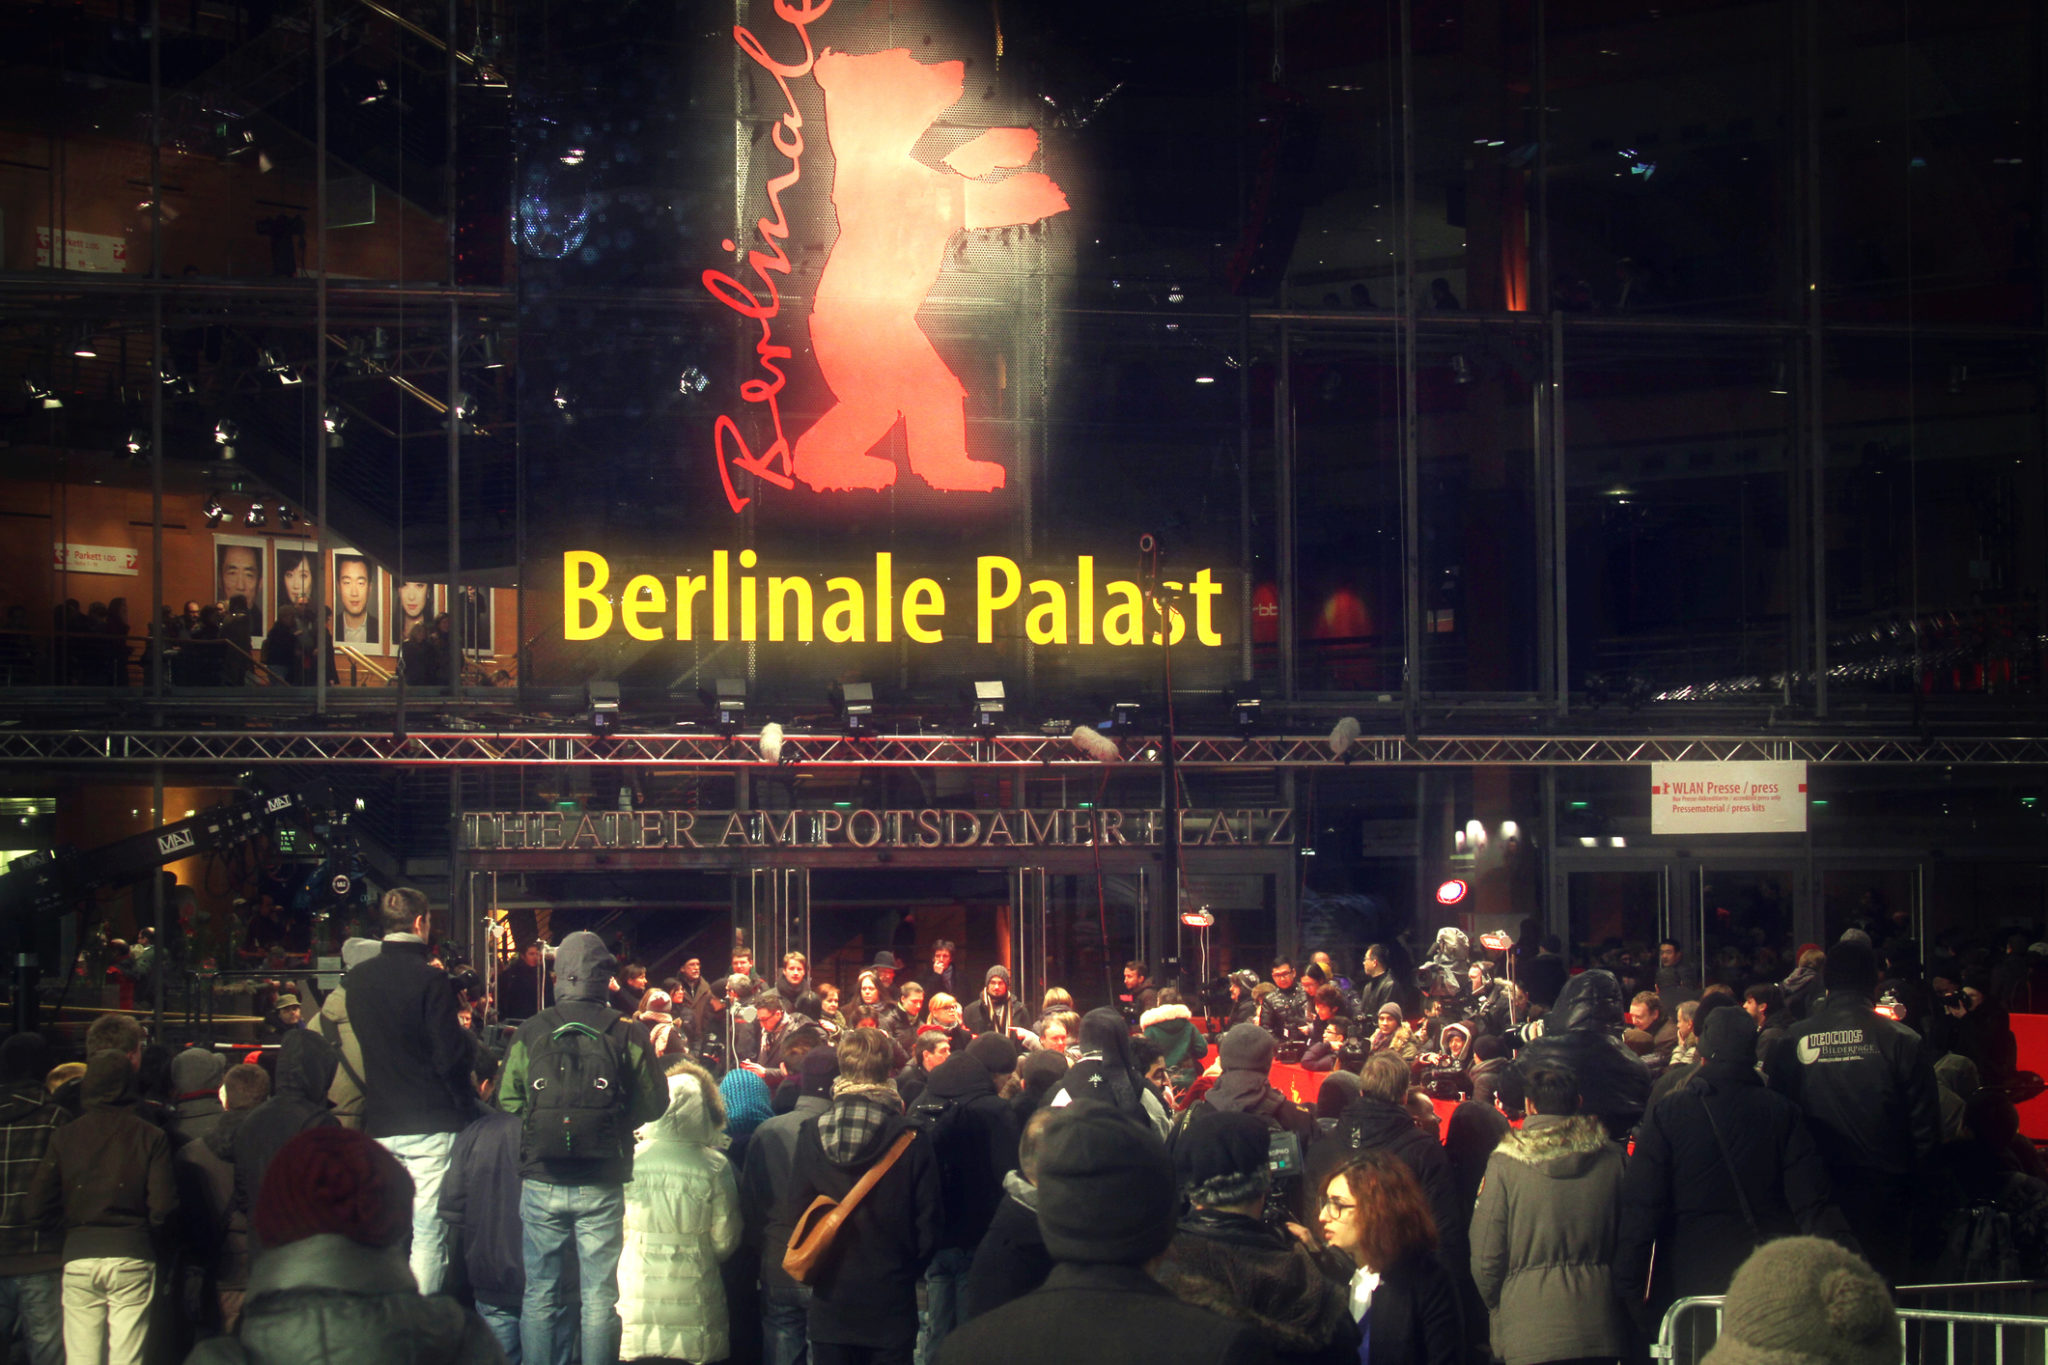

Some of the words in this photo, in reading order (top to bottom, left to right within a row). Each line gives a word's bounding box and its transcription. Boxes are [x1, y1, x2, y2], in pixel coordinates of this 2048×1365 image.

[564, 549, 945, 644] Berlinale
[976, 555, 1222, 646] Palast
[1672, 782, 1704, 794] WLAN
[1707, 782, 1740, 794] Presse
[1751, 784, 1779, 796] press
[267, 794, 292, 812] MAT
[1672, 803, 1725, 813] Pressematerial
[1731, 804, 1751, 815] press
[1752, 803, 1766, 812] kits
[157, 827, 195, 855] MAT
[462, 811, 702, 850] THEATER
[720, 809, 804, 848] AM
[816, 809, 1134, 848] POTSDAMER
